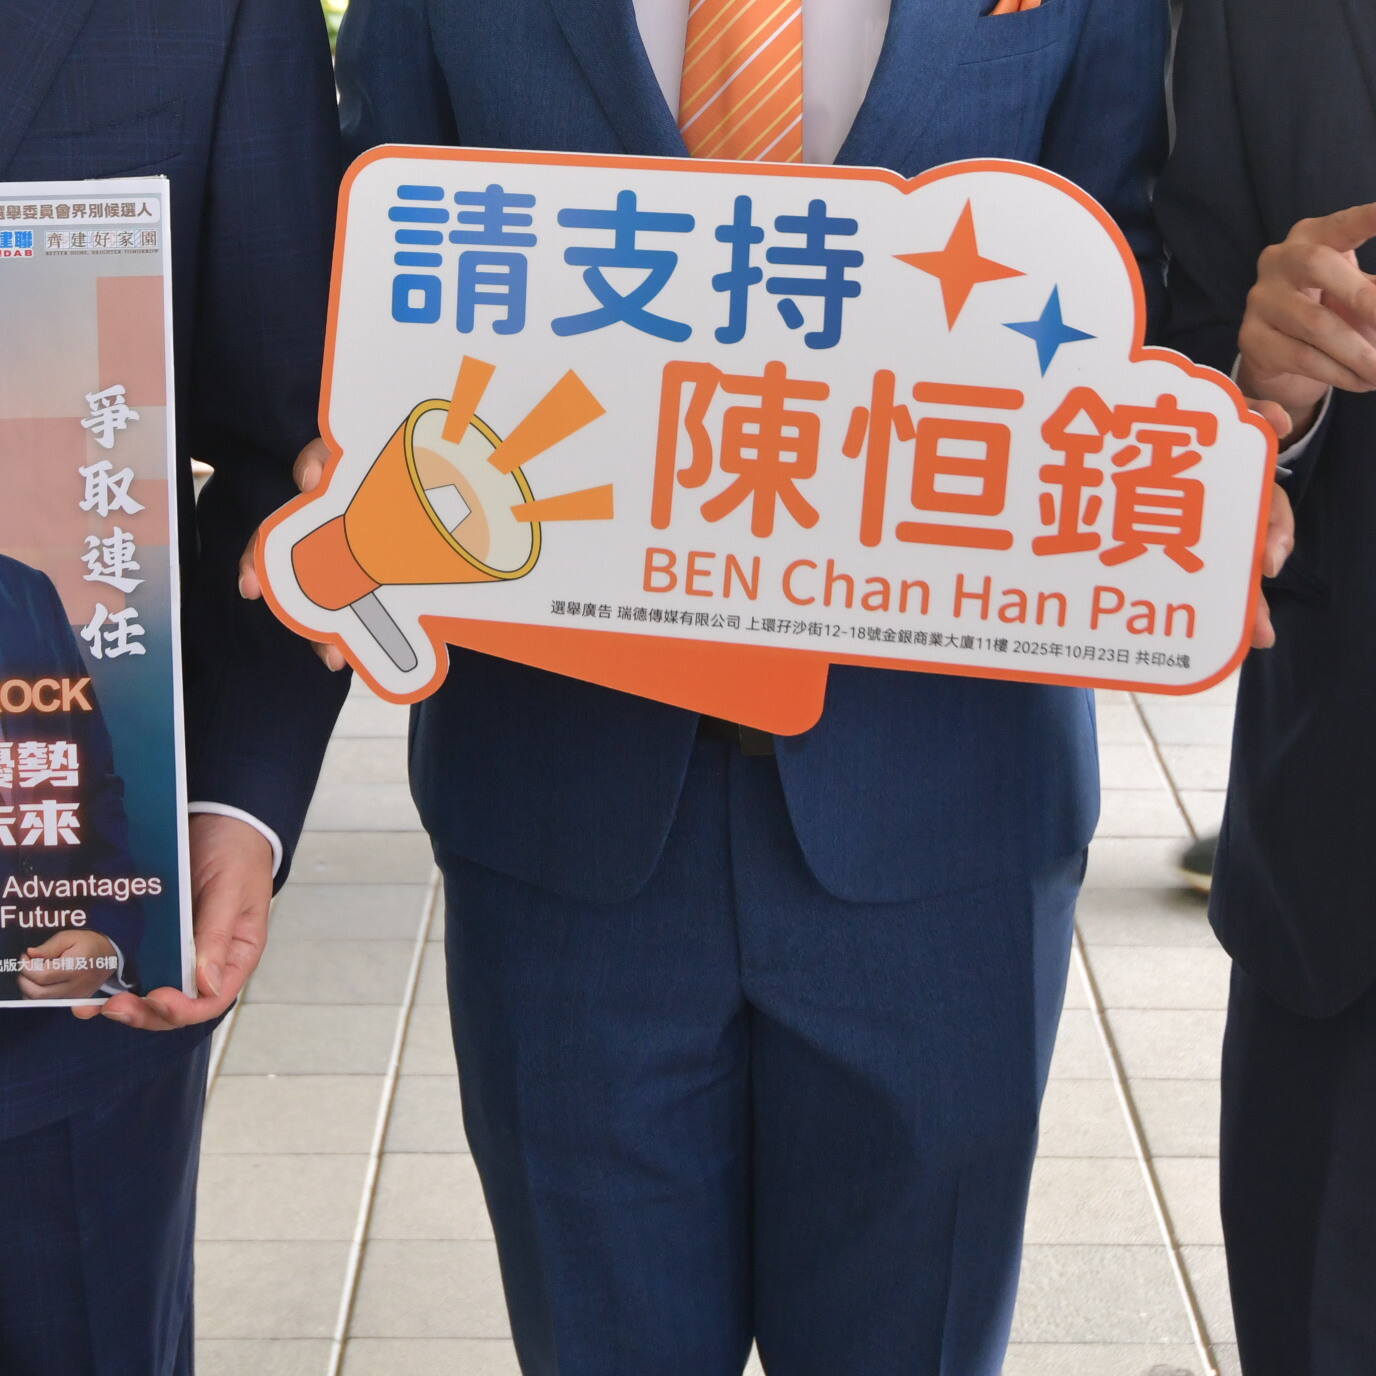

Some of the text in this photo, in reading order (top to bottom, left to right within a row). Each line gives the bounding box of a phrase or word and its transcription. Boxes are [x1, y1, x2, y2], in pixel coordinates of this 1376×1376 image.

[3, 249, 33, 257] DAB
[47, 230, 157, 249] 齊建好家園
[388, 183, 864, 350] 請支持
[650, 360, 1218, 574] 陳恒鑌
[79, 384, 147, 661] 爭取連任
[642, 546, 1197, 640] BEN Chan Han Pan
[550, 599, 613, 620] 選舉廣告
[617, 605, 741, 630] 瑞德傳媒有限公司
[1013, 640, 1130, 664] 2025年10月23日
[1135, 649, 1191, 670] 共印6塊
[0, 904, 87, 929] Future
[2, 873, 163, 906] Advantages
